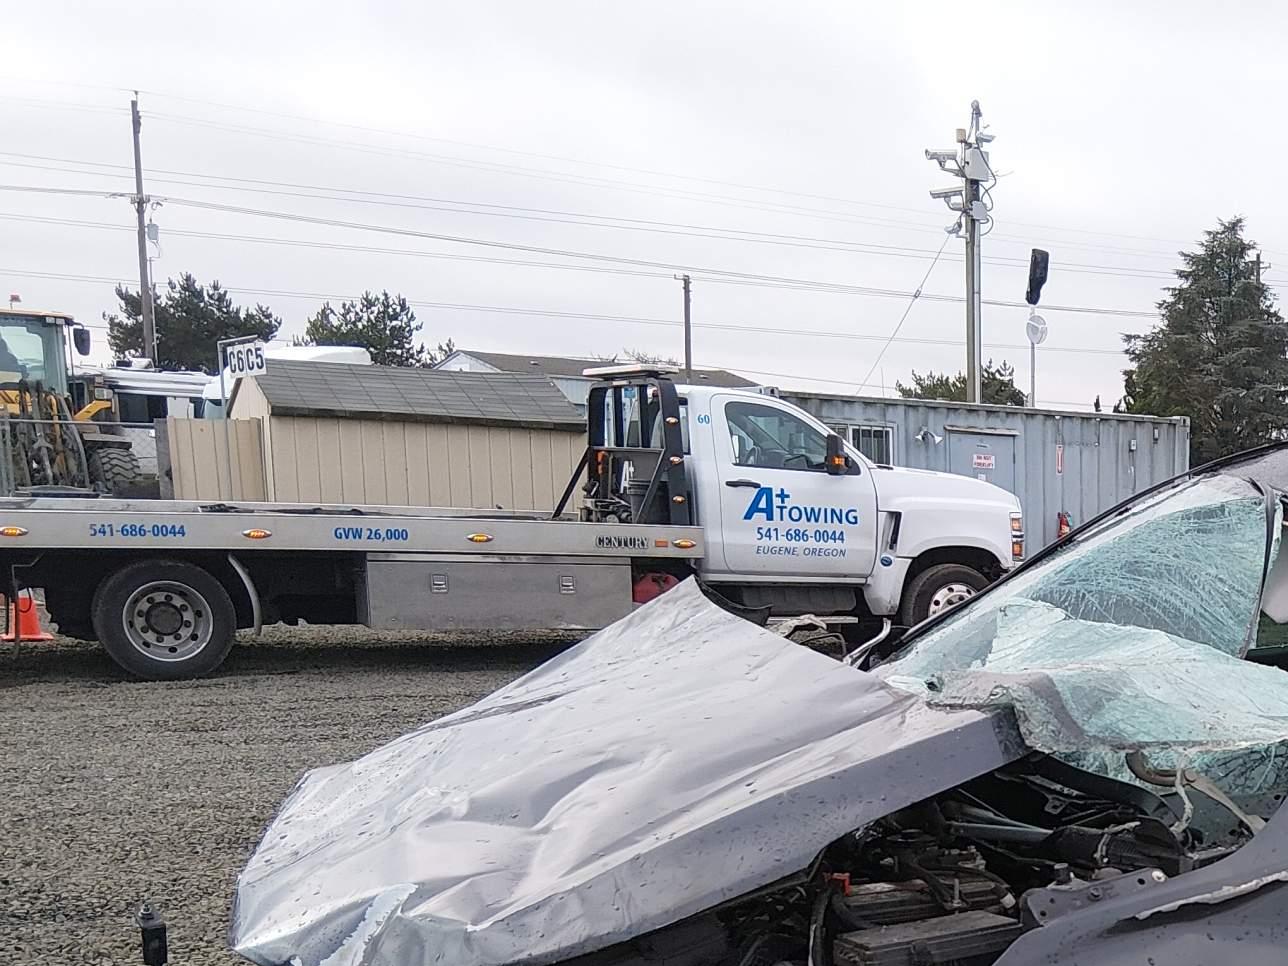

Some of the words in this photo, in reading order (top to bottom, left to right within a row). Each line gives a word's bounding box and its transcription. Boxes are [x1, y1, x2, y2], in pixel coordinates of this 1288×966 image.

[776, 505, 859, 525] TOWING
[88, 523, 186, 538] 541-686-0044
[334, 527, 363, 540] GVW
[366, 528, 409, 542] 26,000
[756, 526, 845, 544] 541-686-0044
[595, 534, 649, 550] CENTURY
[802, 547, 847, 558] OREGON
